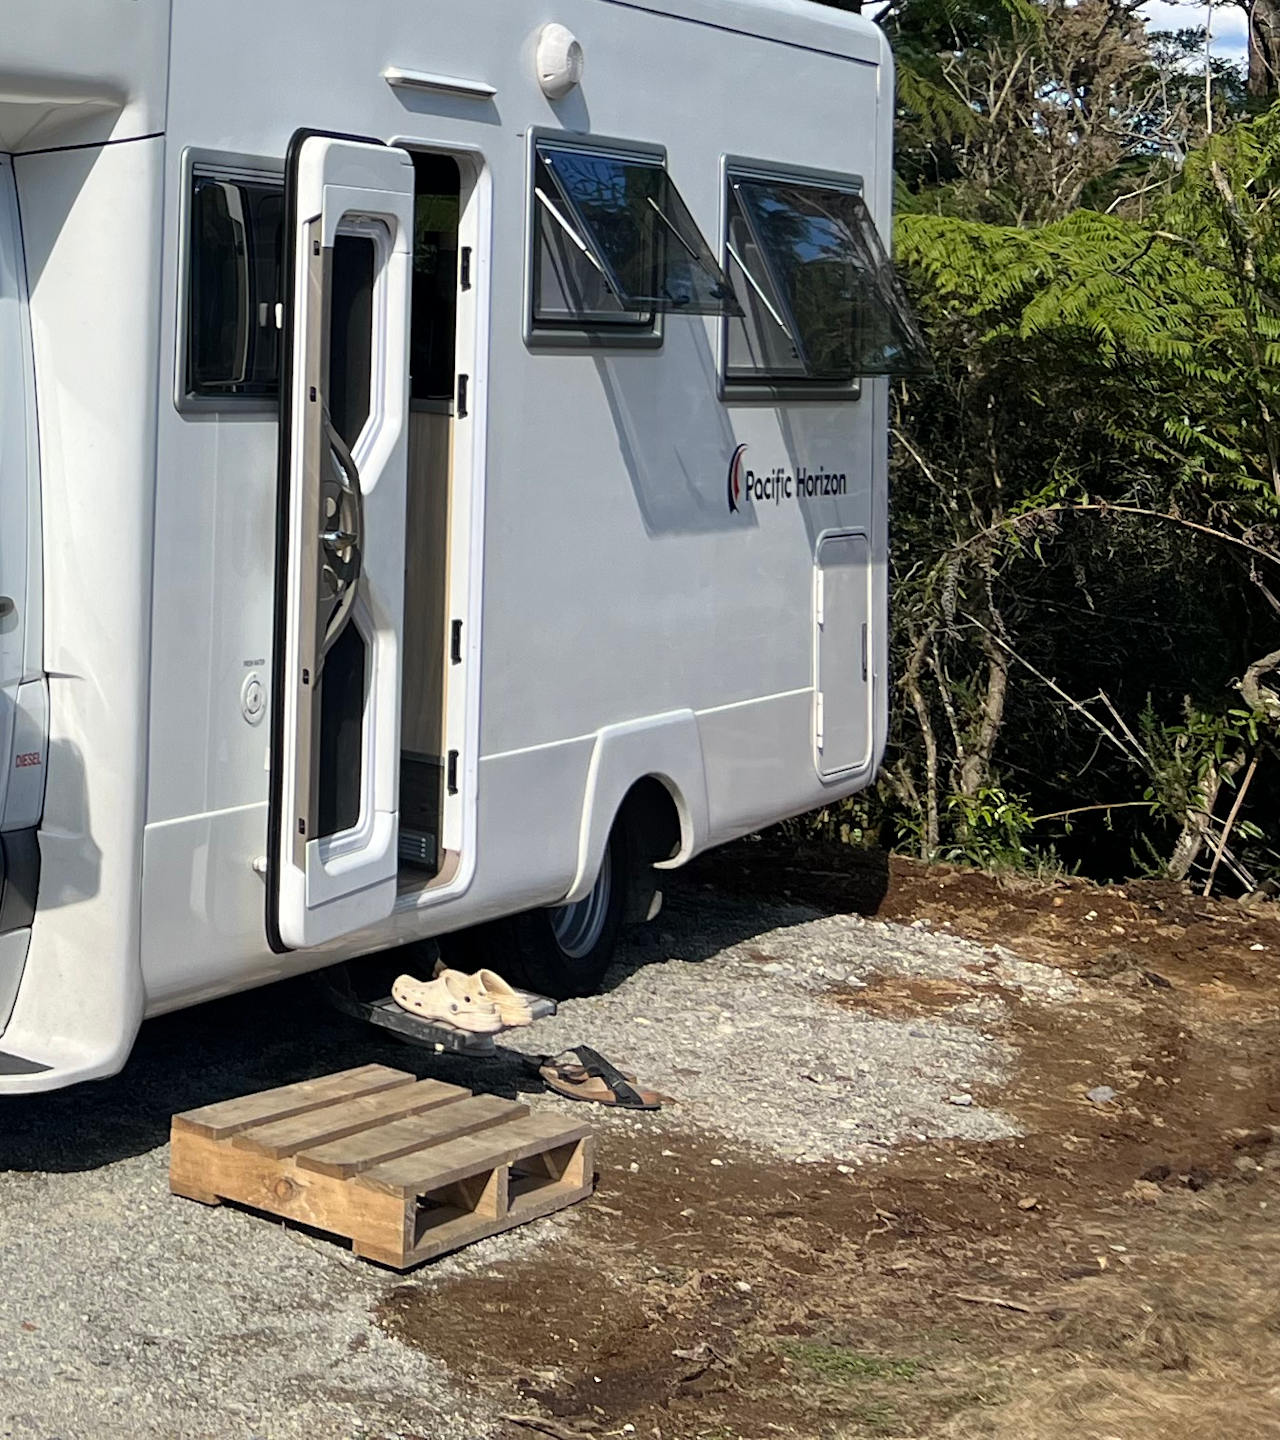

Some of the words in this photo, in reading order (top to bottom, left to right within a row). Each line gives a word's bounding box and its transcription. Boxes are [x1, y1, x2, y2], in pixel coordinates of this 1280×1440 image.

[745, 468, 792, 506] Pacific
[796, 465, 847, 497] Horizon
[15, 751, 42, 768] DIESEL
